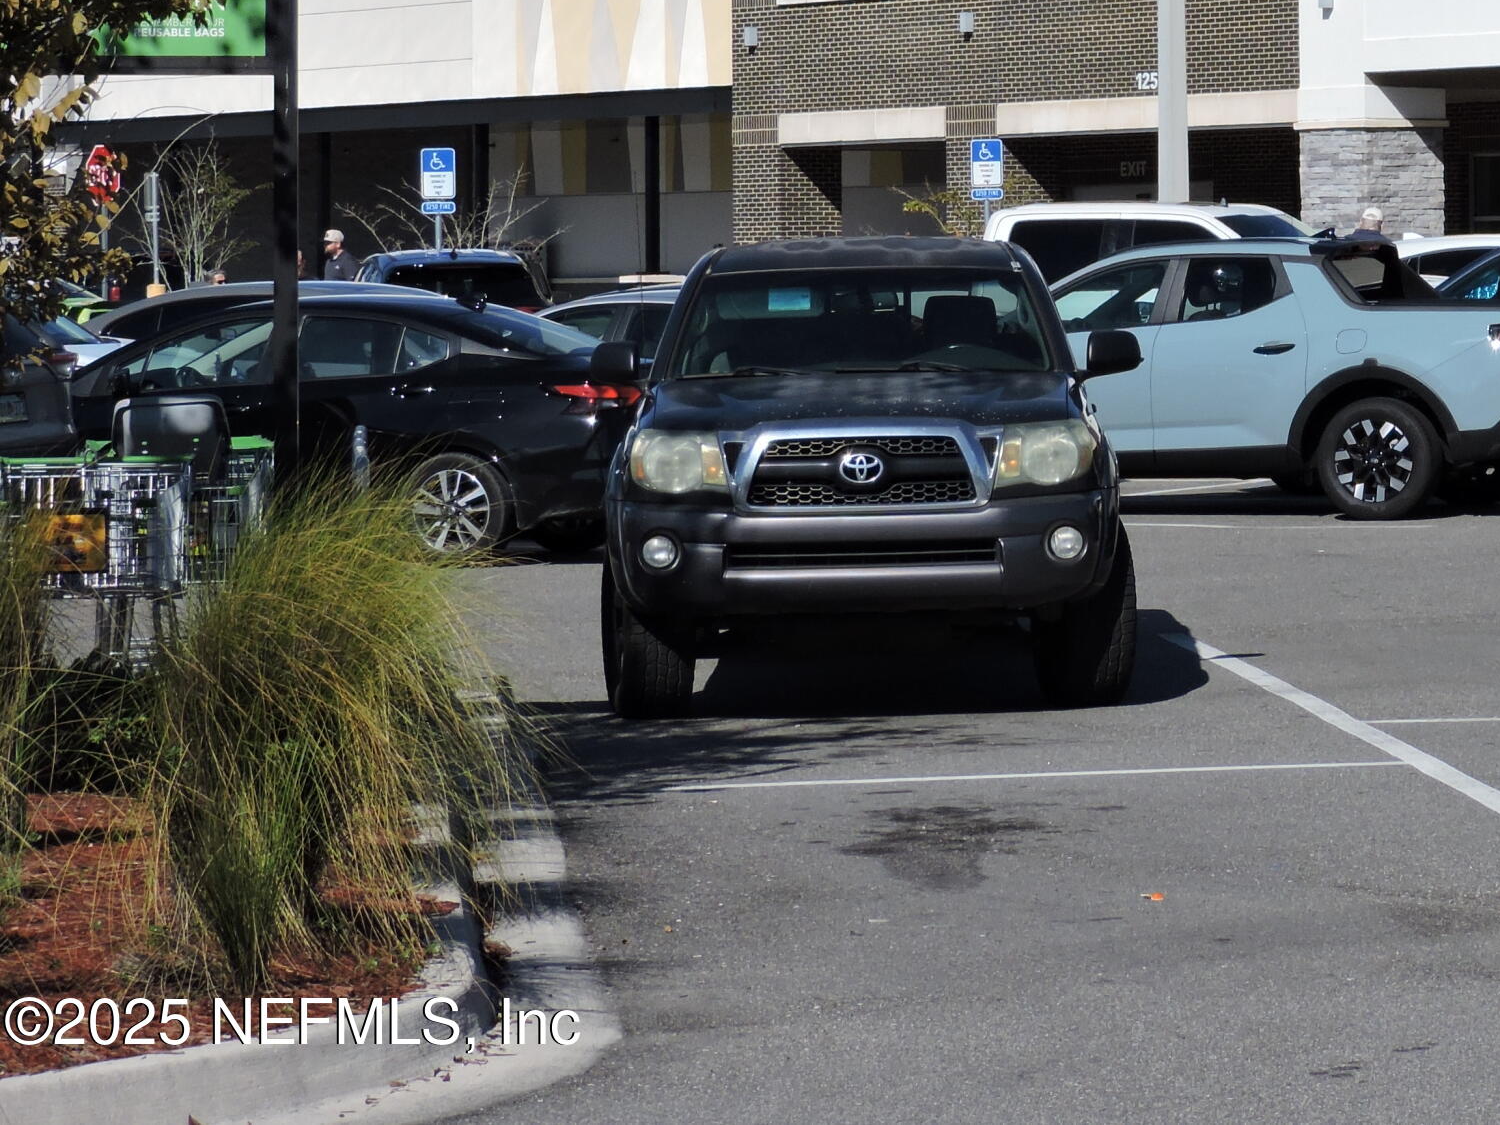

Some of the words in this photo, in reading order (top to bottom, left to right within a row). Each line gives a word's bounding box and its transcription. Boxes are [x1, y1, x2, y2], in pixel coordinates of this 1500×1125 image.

[134, 27, 192, 37] REUSABLE
[194, 27, 225, 37] BAGS
[1120, 160, 1147, 177] EXIT
